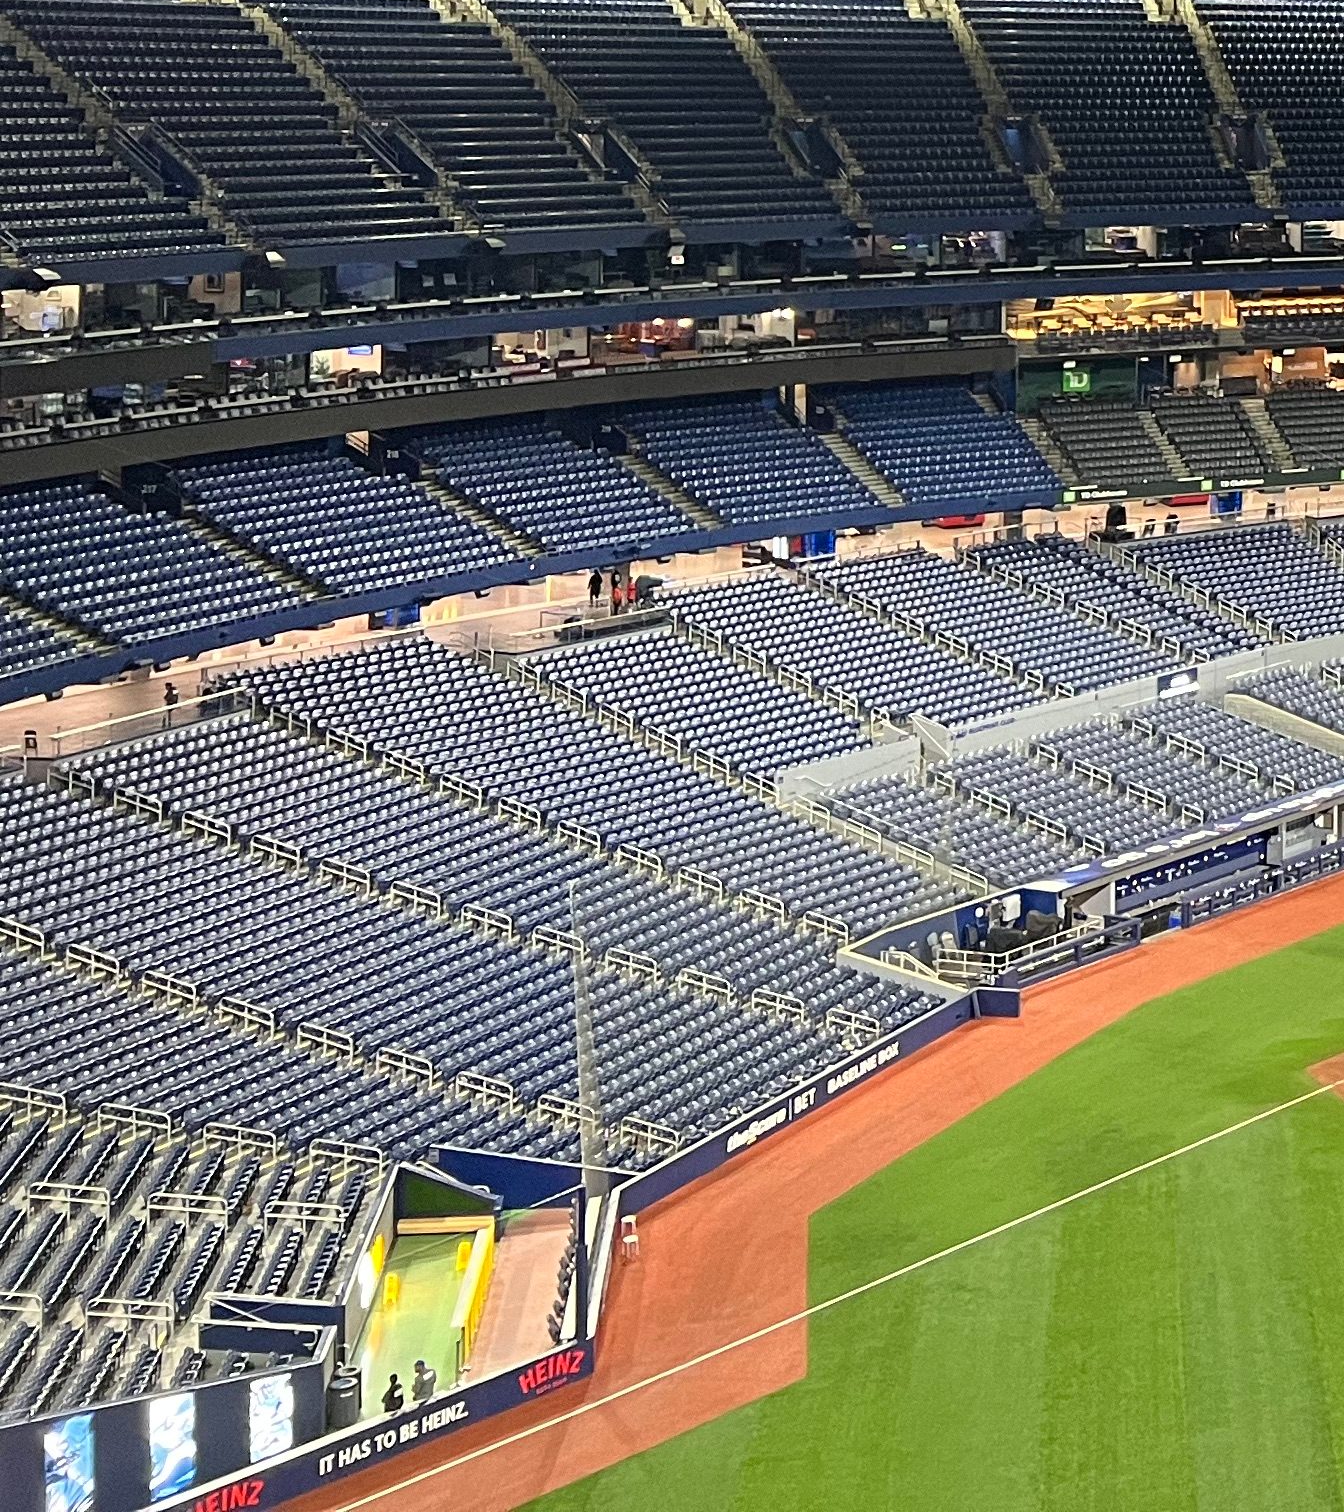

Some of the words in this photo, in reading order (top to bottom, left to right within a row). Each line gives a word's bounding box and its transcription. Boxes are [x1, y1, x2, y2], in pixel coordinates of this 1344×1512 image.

[794, 1087, 817, 1114] BET
[827, 1054, 878, 1094] BASELINE
[878, 1041, 900, 1065] BOX
[519, 1350, 586, 1394] HEINZ
[319, 1453, 335, 1476] IT
[337, 1441, 372, 1469] HAS
[374, 1429, 397, 1454] TO
[399, 1422, 419, 1444] BE
[421, 1401, 469, 1435] HEINZ.
